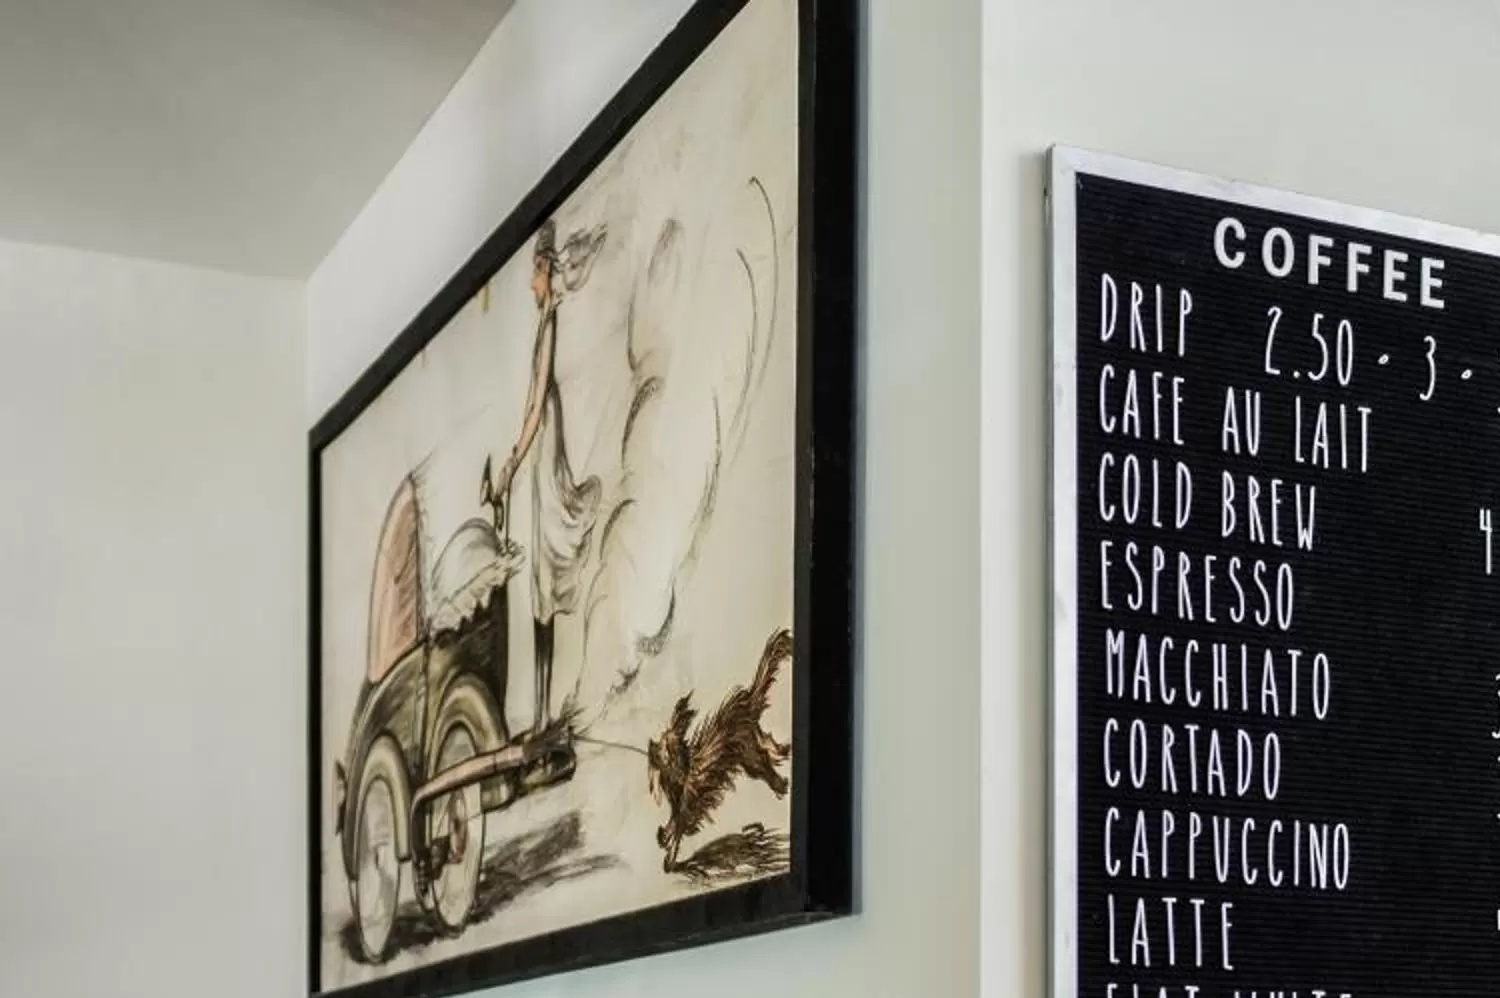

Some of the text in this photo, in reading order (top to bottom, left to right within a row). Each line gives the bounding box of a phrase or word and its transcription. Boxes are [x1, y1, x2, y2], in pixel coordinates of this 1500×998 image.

[1212, 216, 1446, 309] COFFEE
[1100, 272, 1193, 357] DRIP
[1265, 305, 1354, 387] 2.50
[1419, 335, 1437, 401] 3
[1099, 363, 1185, 446] CAFE
[1222, 386, 1261, 457] AU
[1295, 395, 1372, 473] LAIT
[1099, 451, 1192, 529] COLD
[1221, 470, 1316, 551] BREW
[1479, 508, 1493, 575] 4
[1100, 537, 1294, 633] ESPRESSO
[1106, 625, 1330, 723] MACCHIATO
[1103, 717, 1281, 801] CORTADO
[1105, 806, 1350, 890] CAPPUCCINO
[1107, 894, 1234, 971] LATTE
